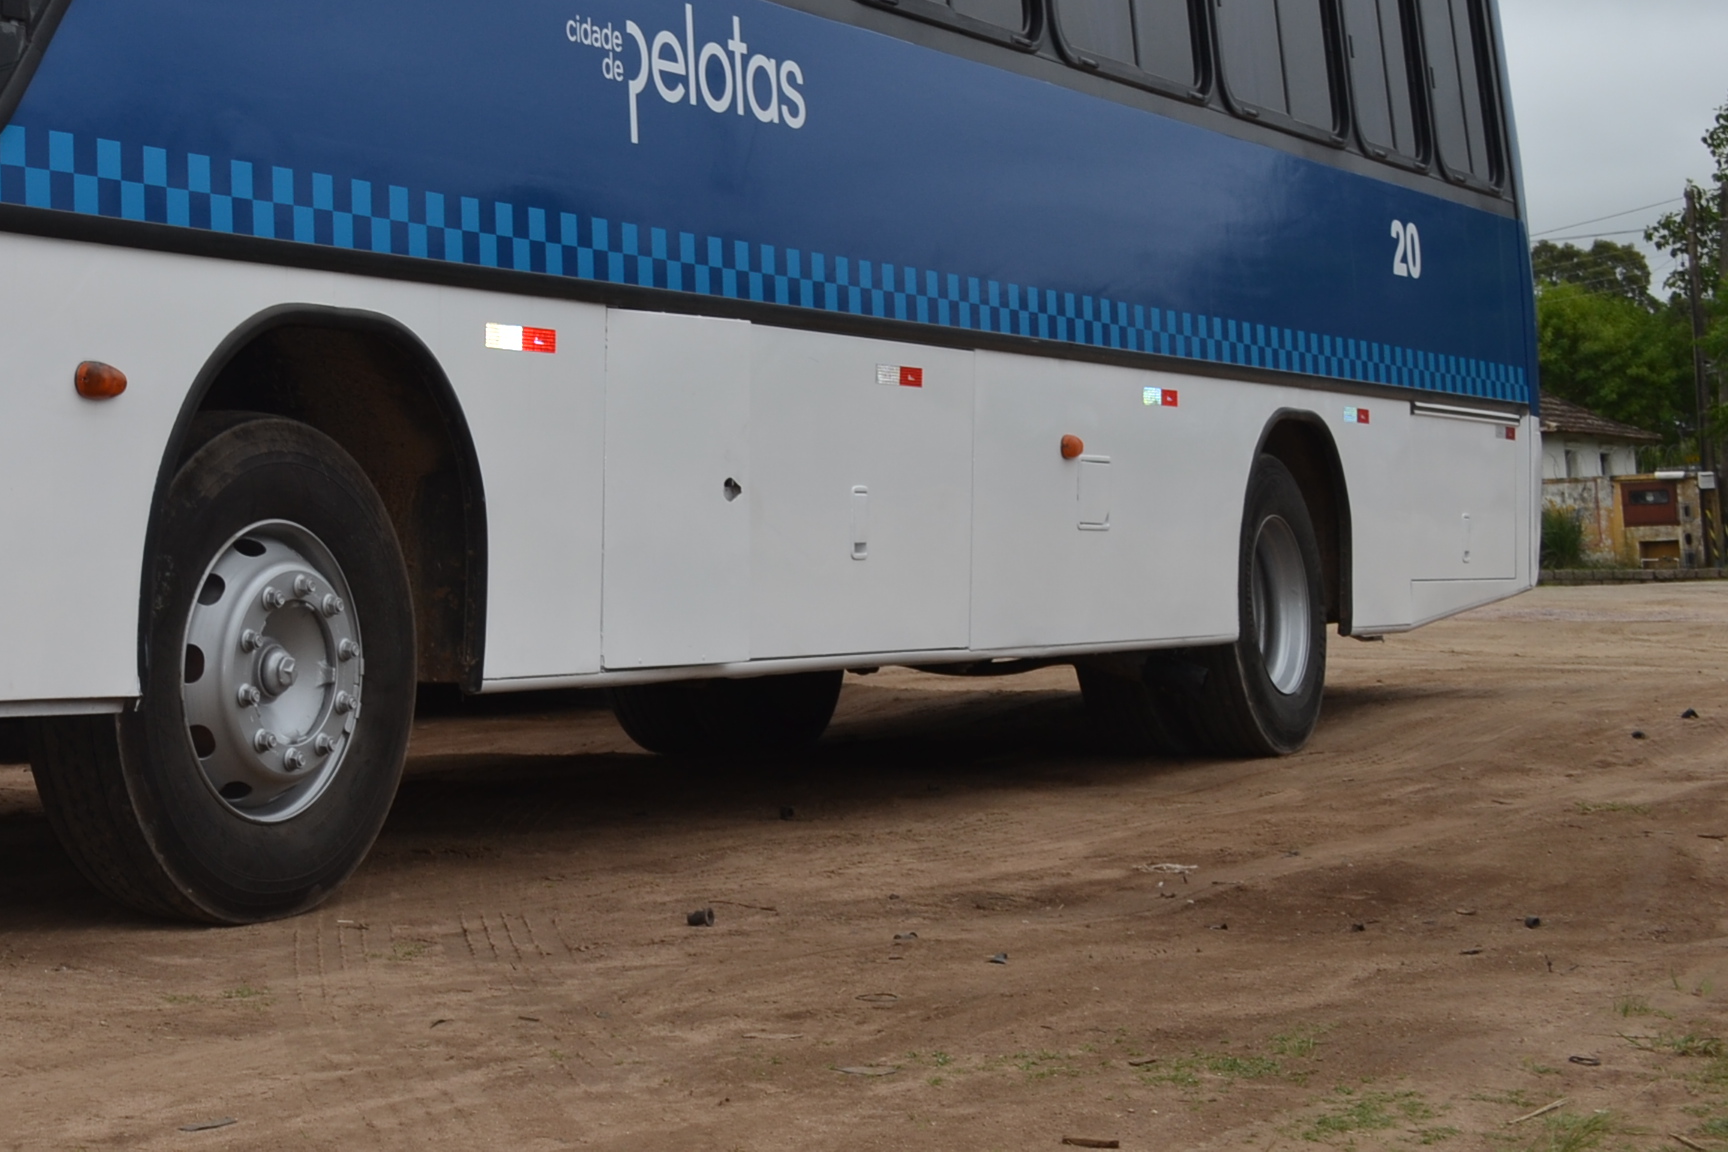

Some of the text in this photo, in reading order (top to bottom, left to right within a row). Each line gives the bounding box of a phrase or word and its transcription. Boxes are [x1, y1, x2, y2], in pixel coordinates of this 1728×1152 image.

[566, 14, 623, 52] cidade
[602, 52, 624, 81] de
[1390, 219, 1422, 279] 20
